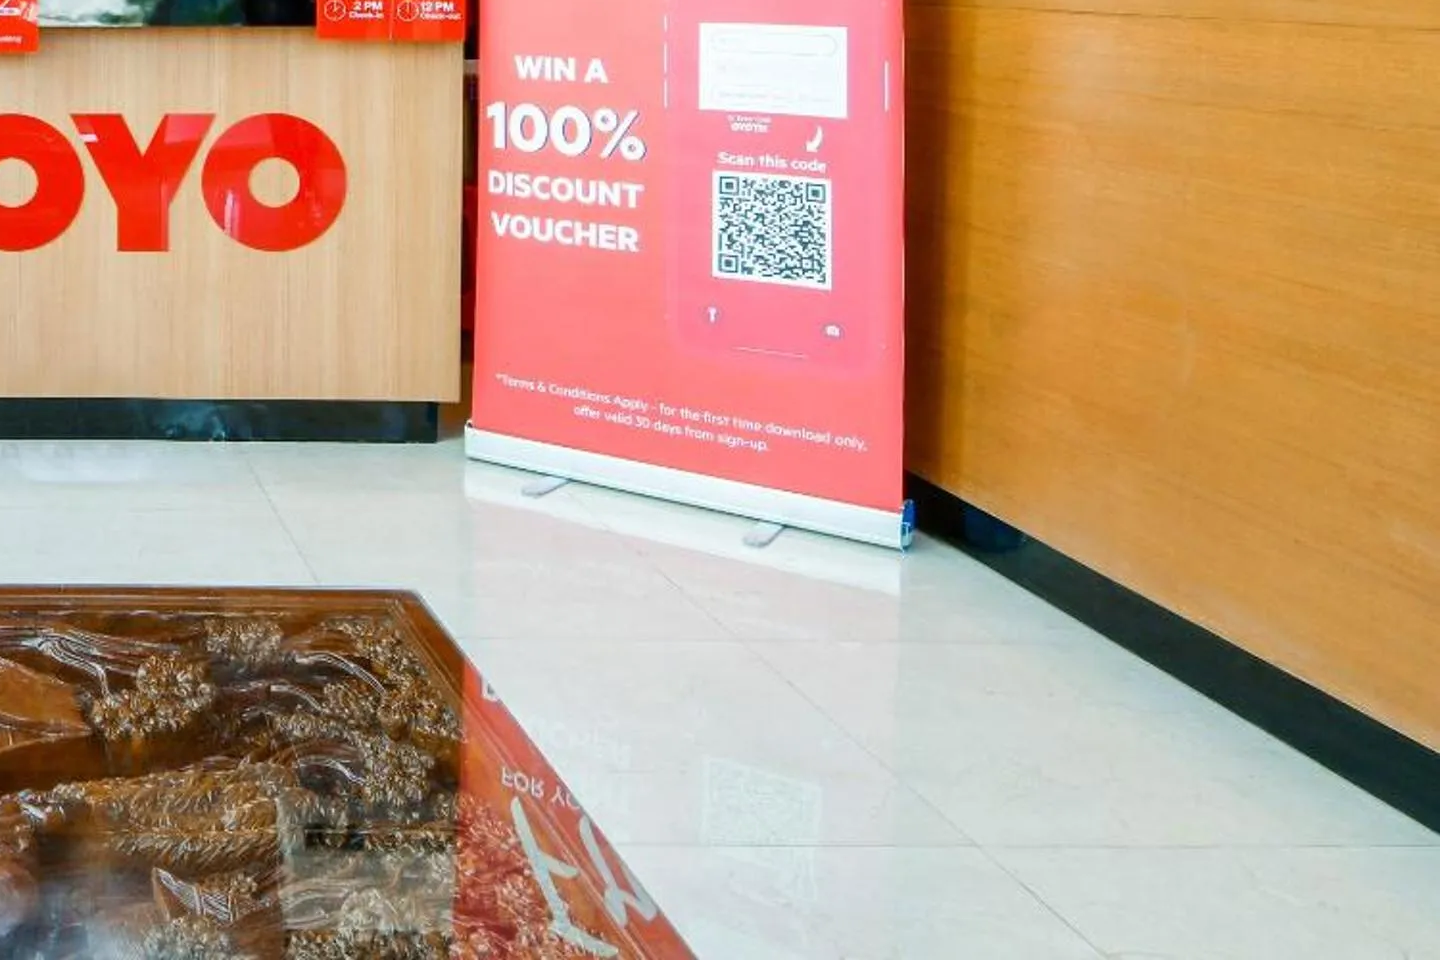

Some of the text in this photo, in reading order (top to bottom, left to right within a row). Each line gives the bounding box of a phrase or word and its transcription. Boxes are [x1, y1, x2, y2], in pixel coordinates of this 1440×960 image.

[353, 0, 383, 11] 2 PM
[435, 1, 454, 12] PM
[514, 54, 609, 84] WIN A
[486, 101, 647, 161] 100%
[717, 151, 827, 174] Scan this code
[488, 169, 646, 209] DISCOUNT
[491, 211, 640, 253] VOUCHER
[537, 381, 546, 393] &
[548, 383, 611, 405] Conditions
[613, 396, 649, 413] Apply
[659, 402, 676, 417] for
[679, 406, 701, 422] the
[703, 410, 730, 425] first
[732, 415, 762, 432] time
[763, 421, 831, 446] download
[834, 435, 868, 452] only.
[573, 405, 601, 420] offer
[604, 410, 633, 426] valid
[635, 415, 650, 430] 30
[654, 417, 682, 436] days
[684, 426, 714, 442] from
